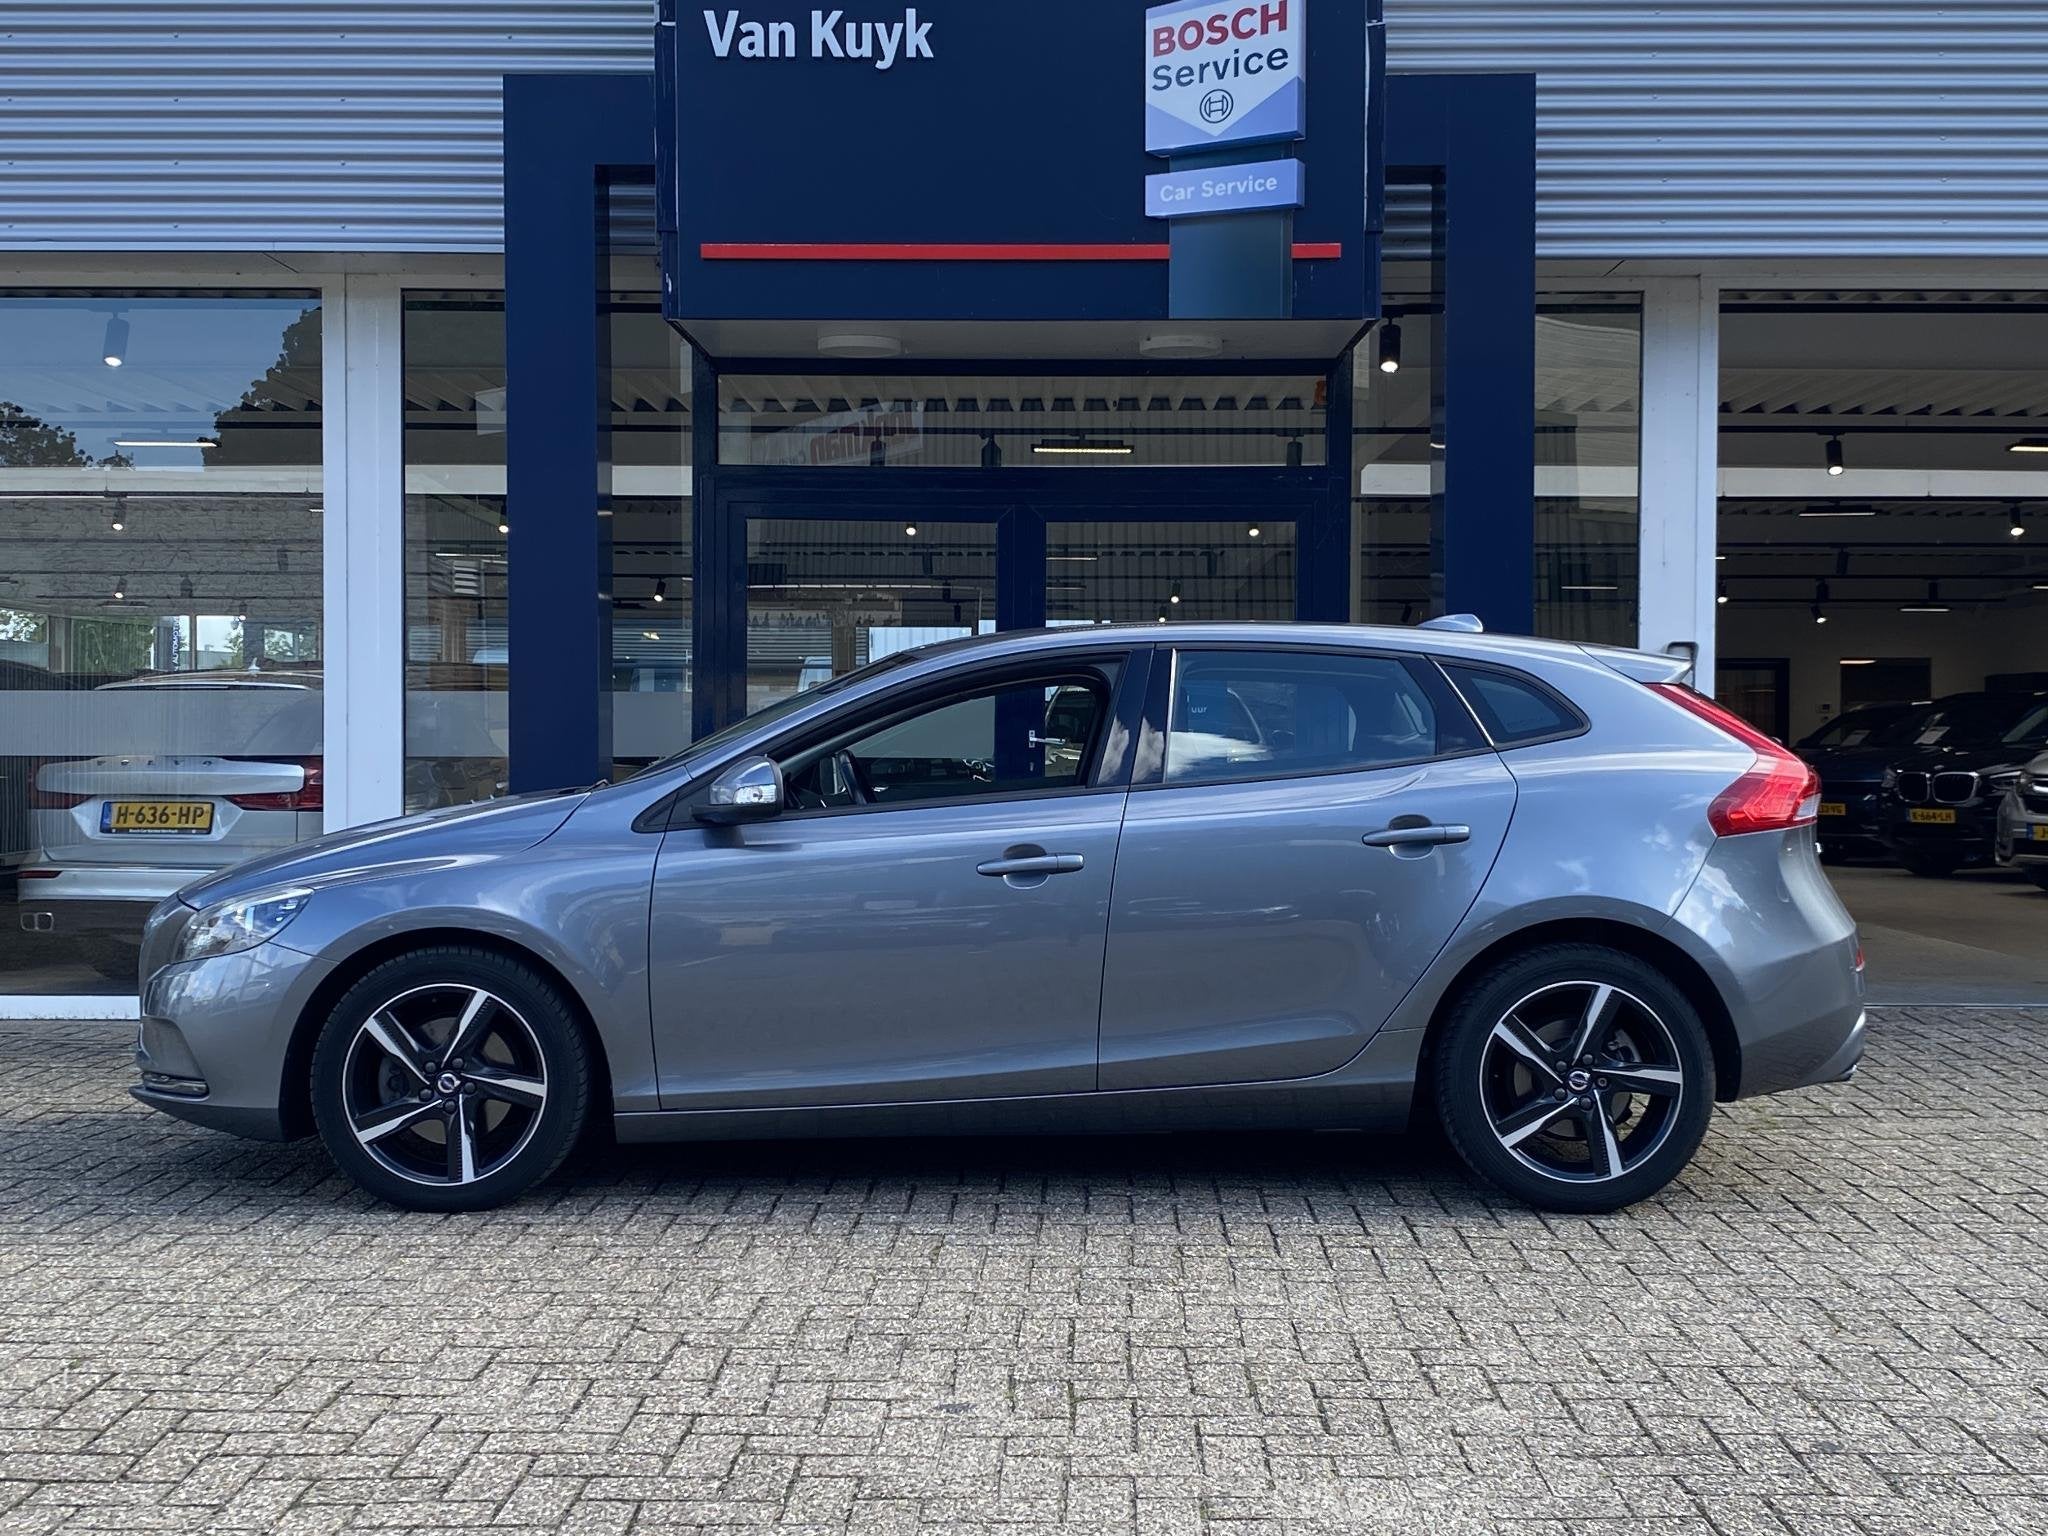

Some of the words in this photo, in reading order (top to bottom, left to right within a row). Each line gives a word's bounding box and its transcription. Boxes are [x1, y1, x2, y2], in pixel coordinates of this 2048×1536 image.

[703, 10, 796, 58] Van
[811, 8, 934, 70] Kuyk
[1153, 0, 1288, 57] BOSCH
[1152, 47, 1289, 91] Service
[1160, 184, 1195, 202] Car
[1201, 175, 1278, 198] Service
[115, 806, 205, 825] H-636-HP
